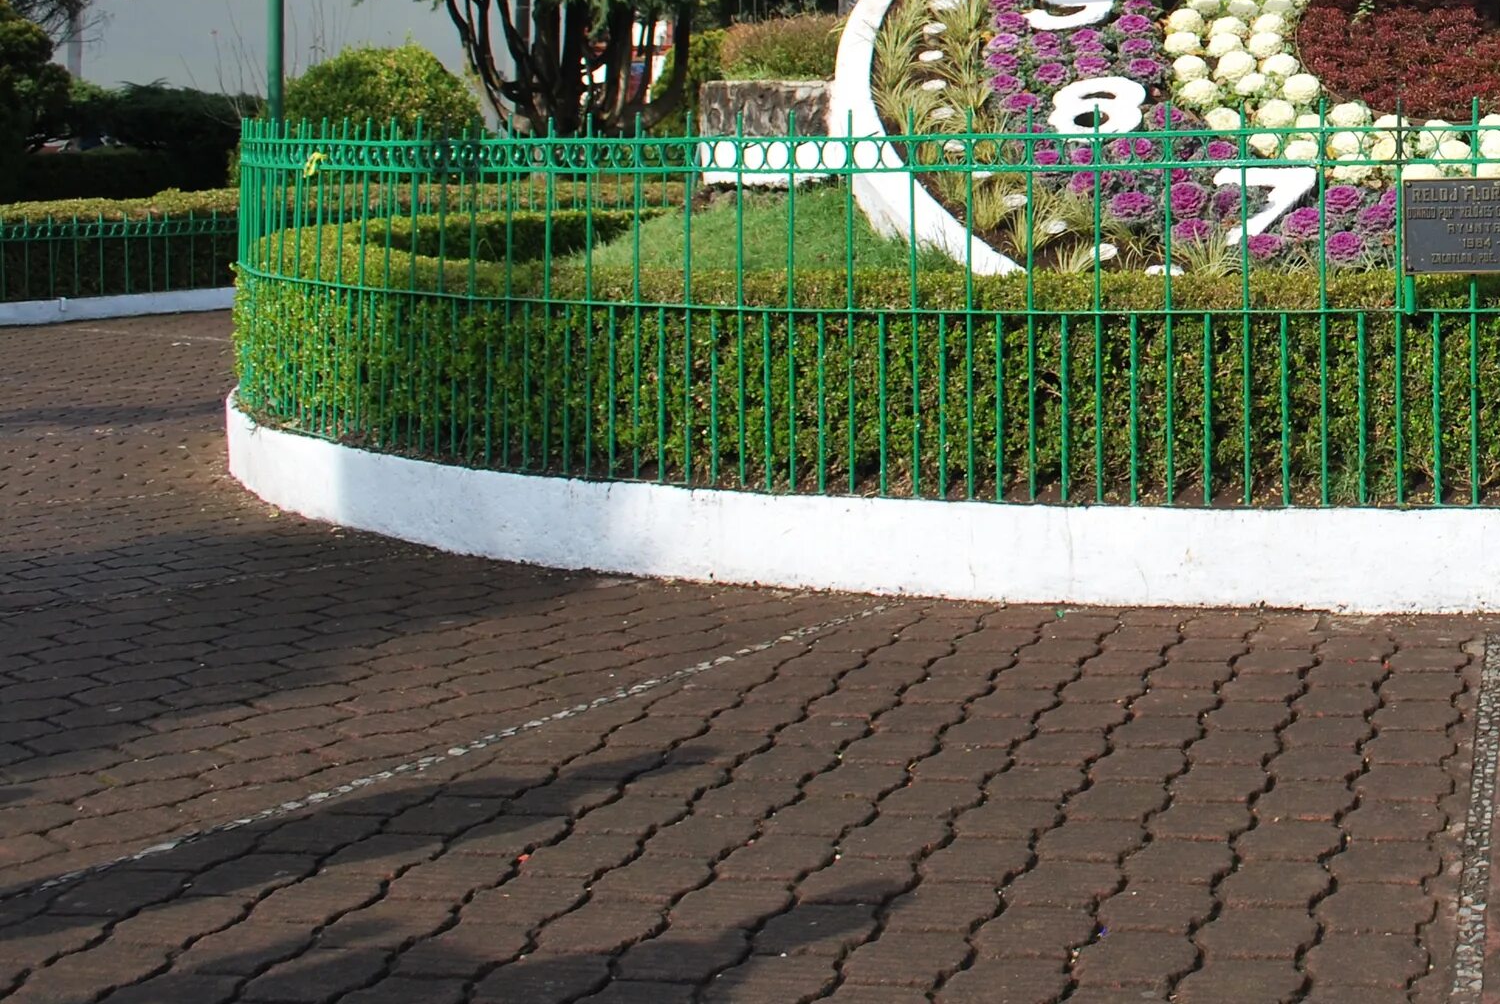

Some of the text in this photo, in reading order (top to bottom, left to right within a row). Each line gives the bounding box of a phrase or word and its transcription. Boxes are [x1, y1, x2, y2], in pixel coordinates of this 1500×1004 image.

[1048, 76, 1147, 142] 8
[1411, 187, 1459, 203] RELOJ
[1214, 166, 1316, 246] 7
[1439, 208, 1454, 220] POR
[1462, 237, 1491, 250] 1984
